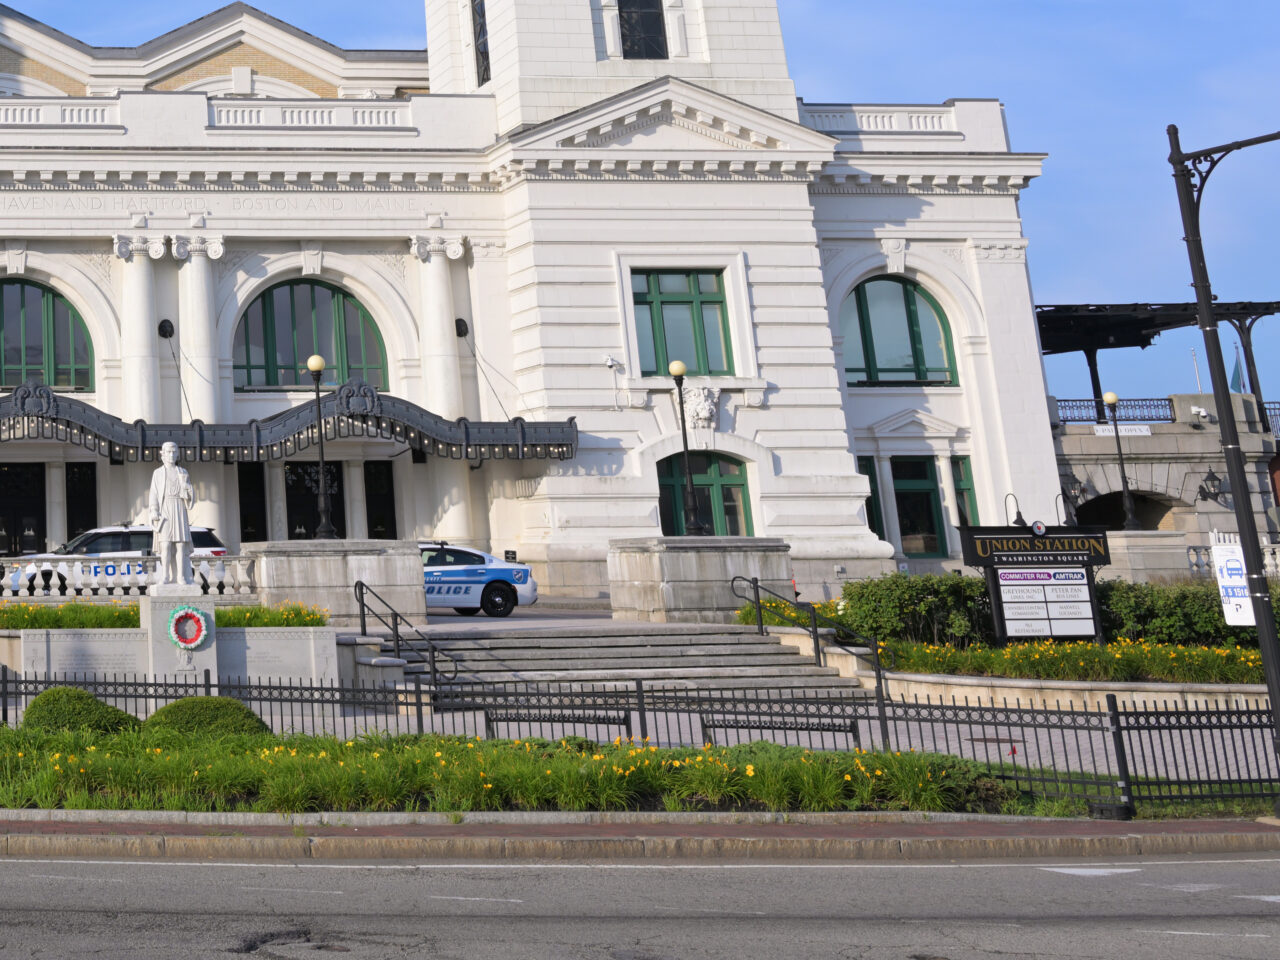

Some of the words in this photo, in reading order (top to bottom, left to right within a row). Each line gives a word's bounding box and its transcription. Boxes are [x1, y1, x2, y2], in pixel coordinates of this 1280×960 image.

[63, 196, 103, 210] AND
[112, 196, 208, 211] HARTFORD
[231, 197, 298, 211] BOSTON
[304, 197, 344, 211] AND
[354, 197, 419, 212] MAINE
[975, 539, 1031, 558] UNION
[1034, 538, 1105, 556] STATION
